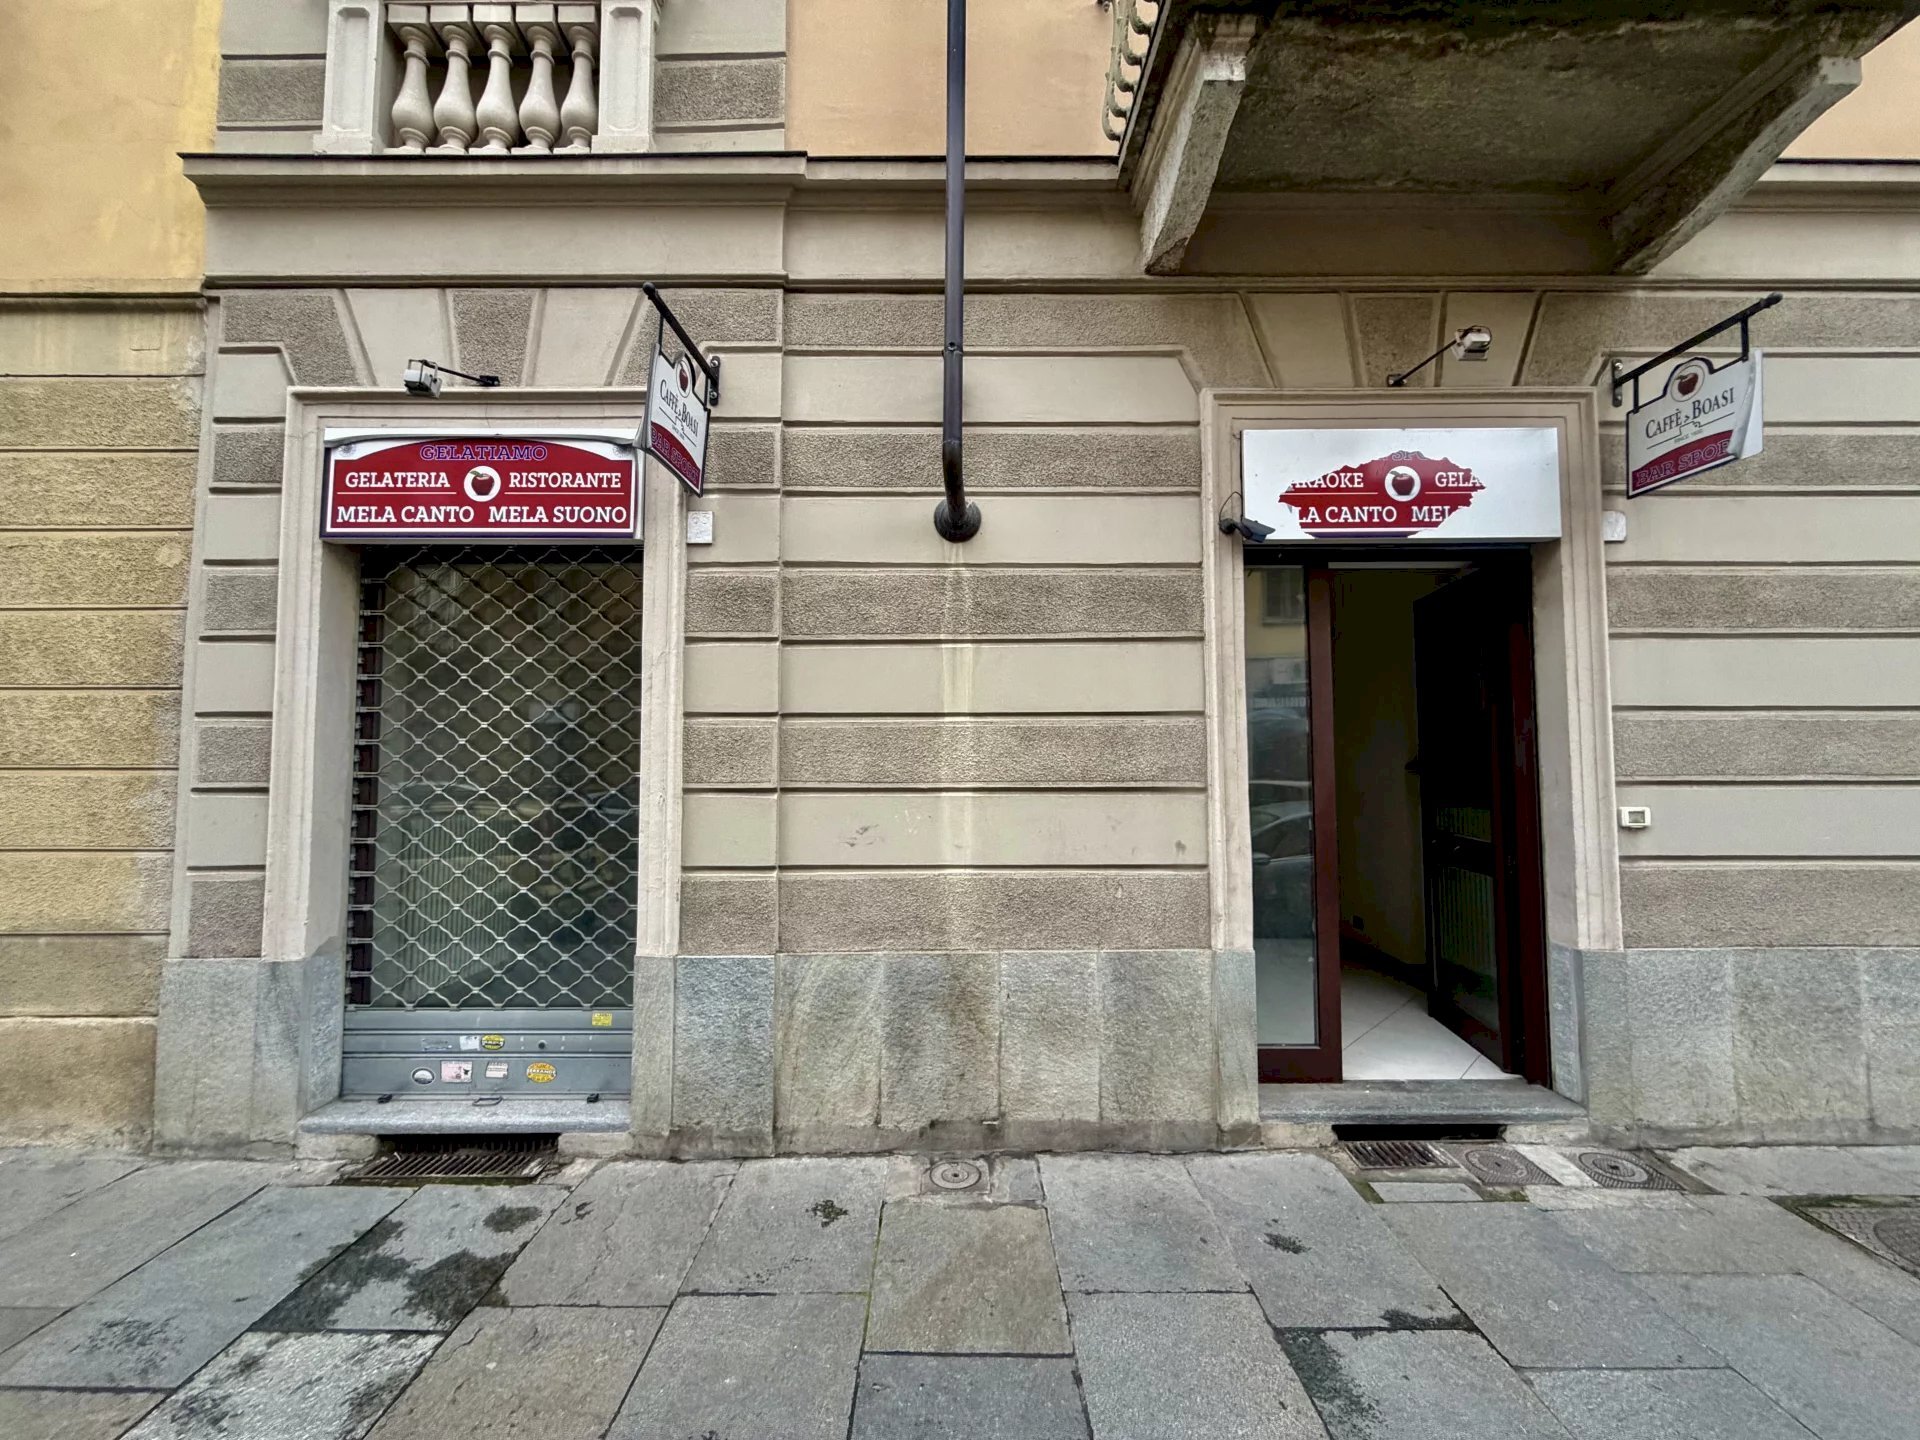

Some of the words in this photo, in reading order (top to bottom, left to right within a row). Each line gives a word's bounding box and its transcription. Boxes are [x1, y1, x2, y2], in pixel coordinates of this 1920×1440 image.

[682, 402, 699, 437] BOASI
[1645, 408, 1683, 439] CAFFÈ
[1692, 387, 1735, 420] BOASI
[419, 444, 548, 461] GELATIAMO
[345, 471, 451, 488] GELATERIA
[508, 471, 622, 488] RISTORANTE
[1636, 460, 1675, 488] BAR
[336, 505, 397, 523] MELA
[401, 505, 475, 523] CANTO
[488, 506, 549, 523] MELA
[553, 506, 627, 524] SUONO
[1325, 505, 1397, 523] CANTO
